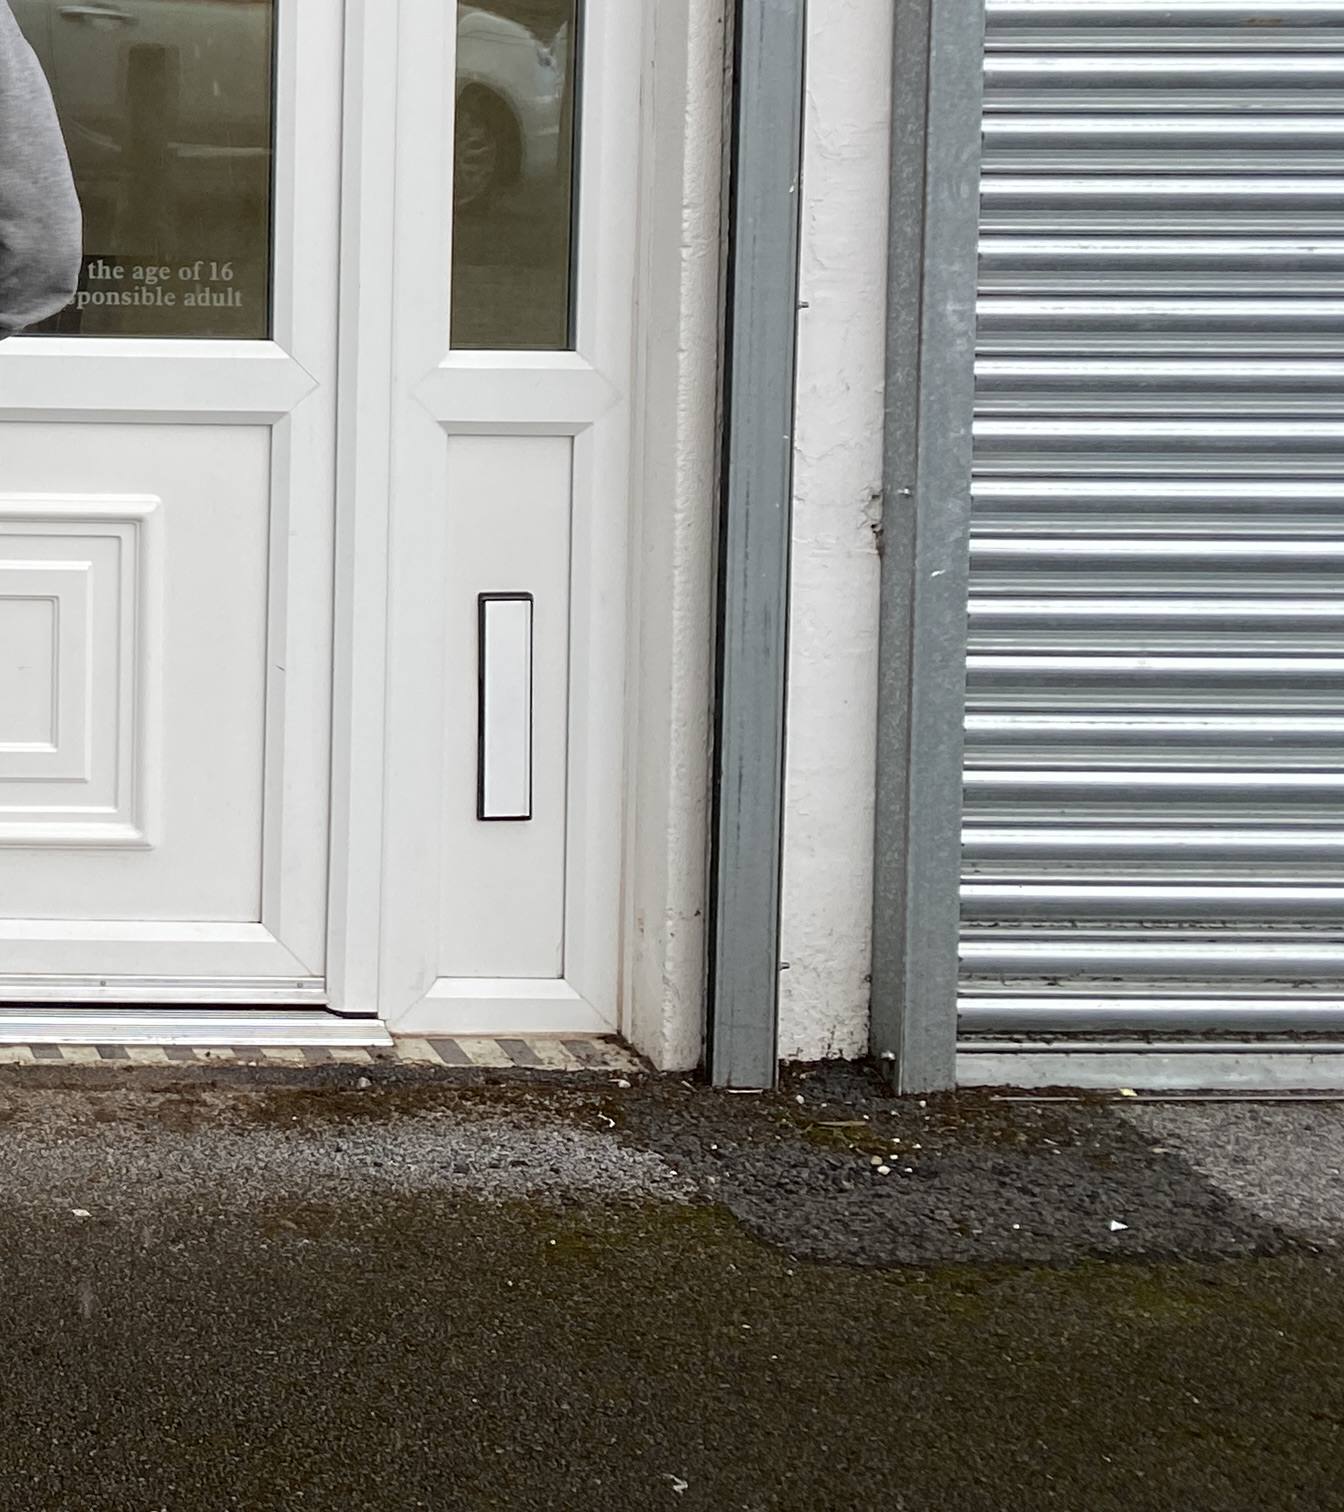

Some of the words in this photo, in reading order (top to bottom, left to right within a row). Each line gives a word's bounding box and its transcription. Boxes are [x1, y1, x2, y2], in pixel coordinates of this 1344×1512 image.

[88, 259, 125, 280] the
[132, 264, 171, 285] age
[179, 259, 204, 280] of
[209, 261, 234, 281] 16
[184, 285, 243, 307] adult
